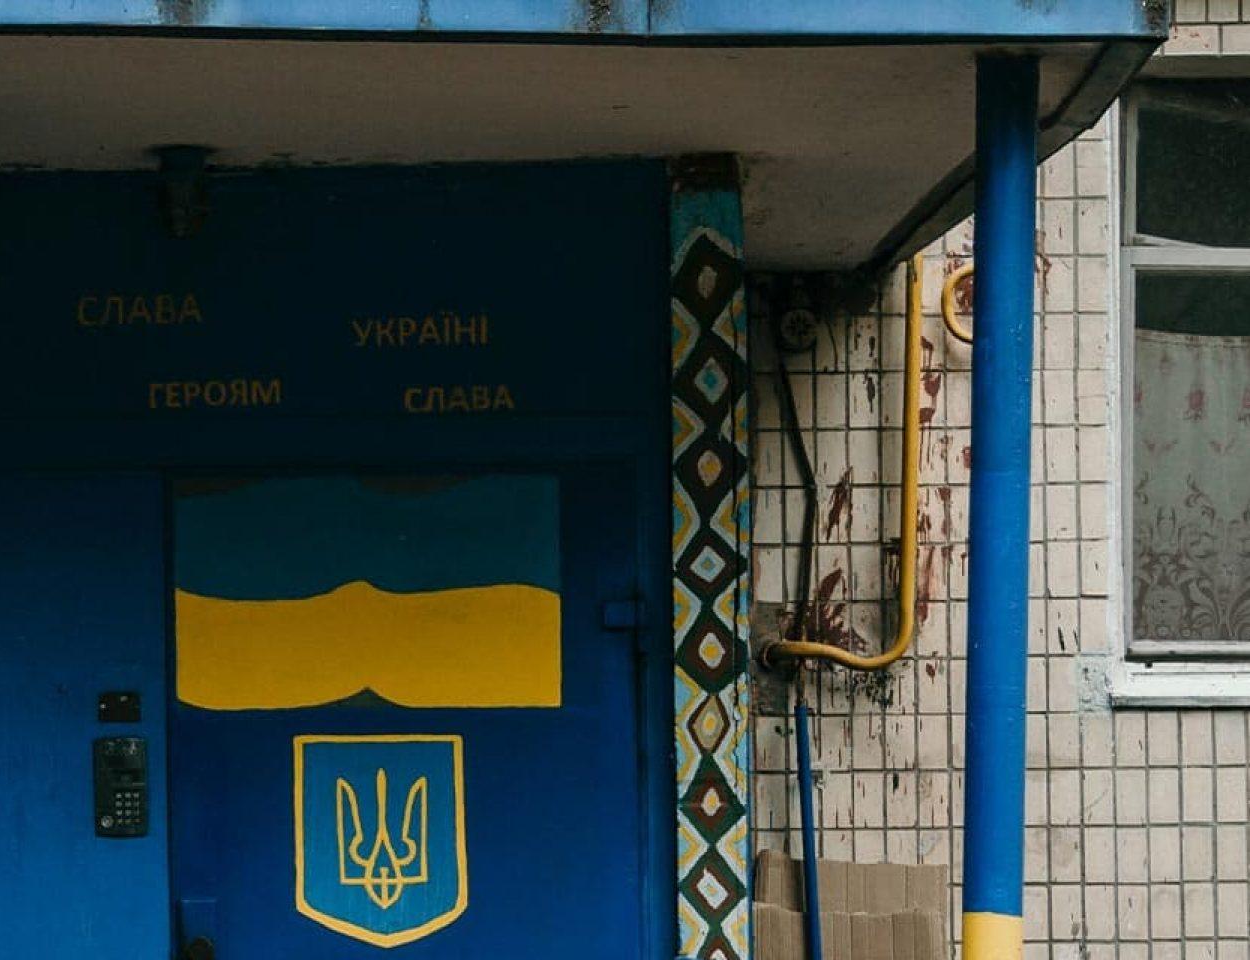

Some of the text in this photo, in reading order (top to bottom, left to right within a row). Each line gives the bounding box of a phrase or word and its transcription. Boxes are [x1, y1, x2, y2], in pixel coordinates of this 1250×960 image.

[76, 294, 489, 347] СЛАВА УКРАЇНІ
[147, 378, 515, 414] ГЕРОЯМ СЛАВА
